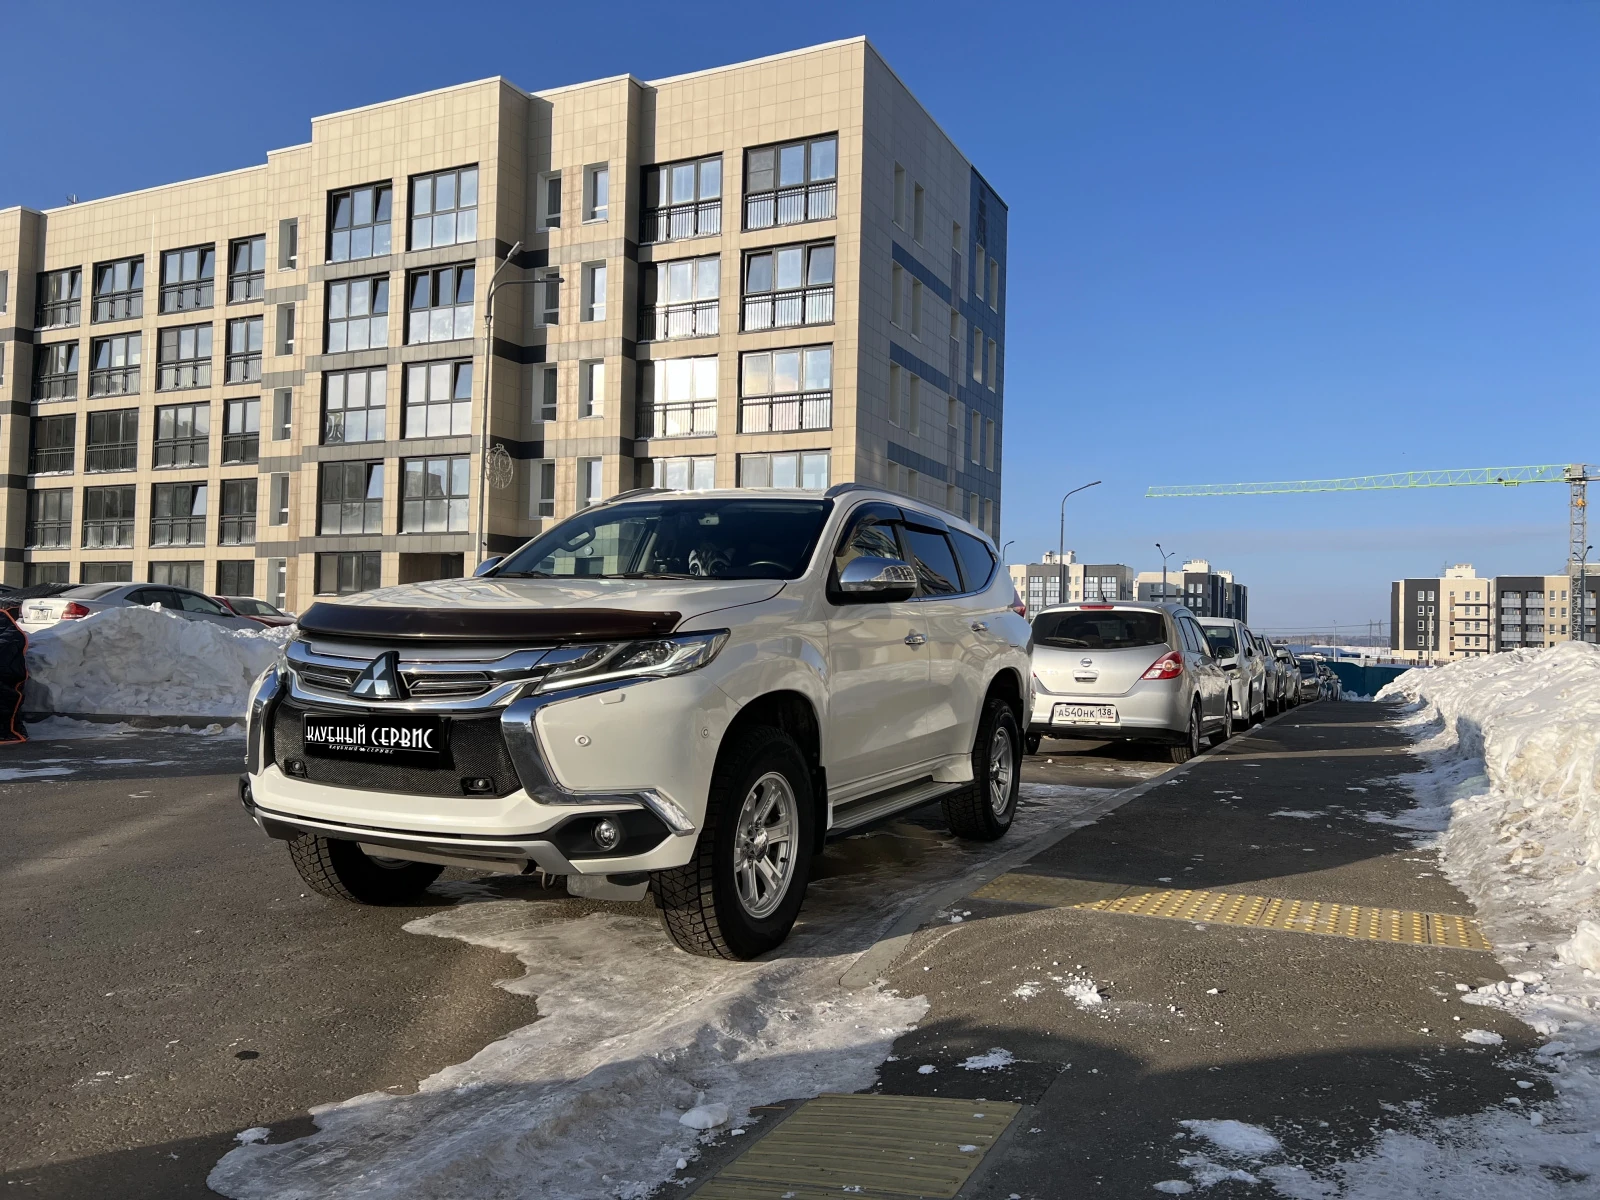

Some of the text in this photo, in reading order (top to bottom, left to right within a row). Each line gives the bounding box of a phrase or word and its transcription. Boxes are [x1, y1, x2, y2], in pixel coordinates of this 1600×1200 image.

[1097, 708, 1112, 716] 138
[306, 724, 434, 748] КЛУБНЫЙ СЕРВИС
